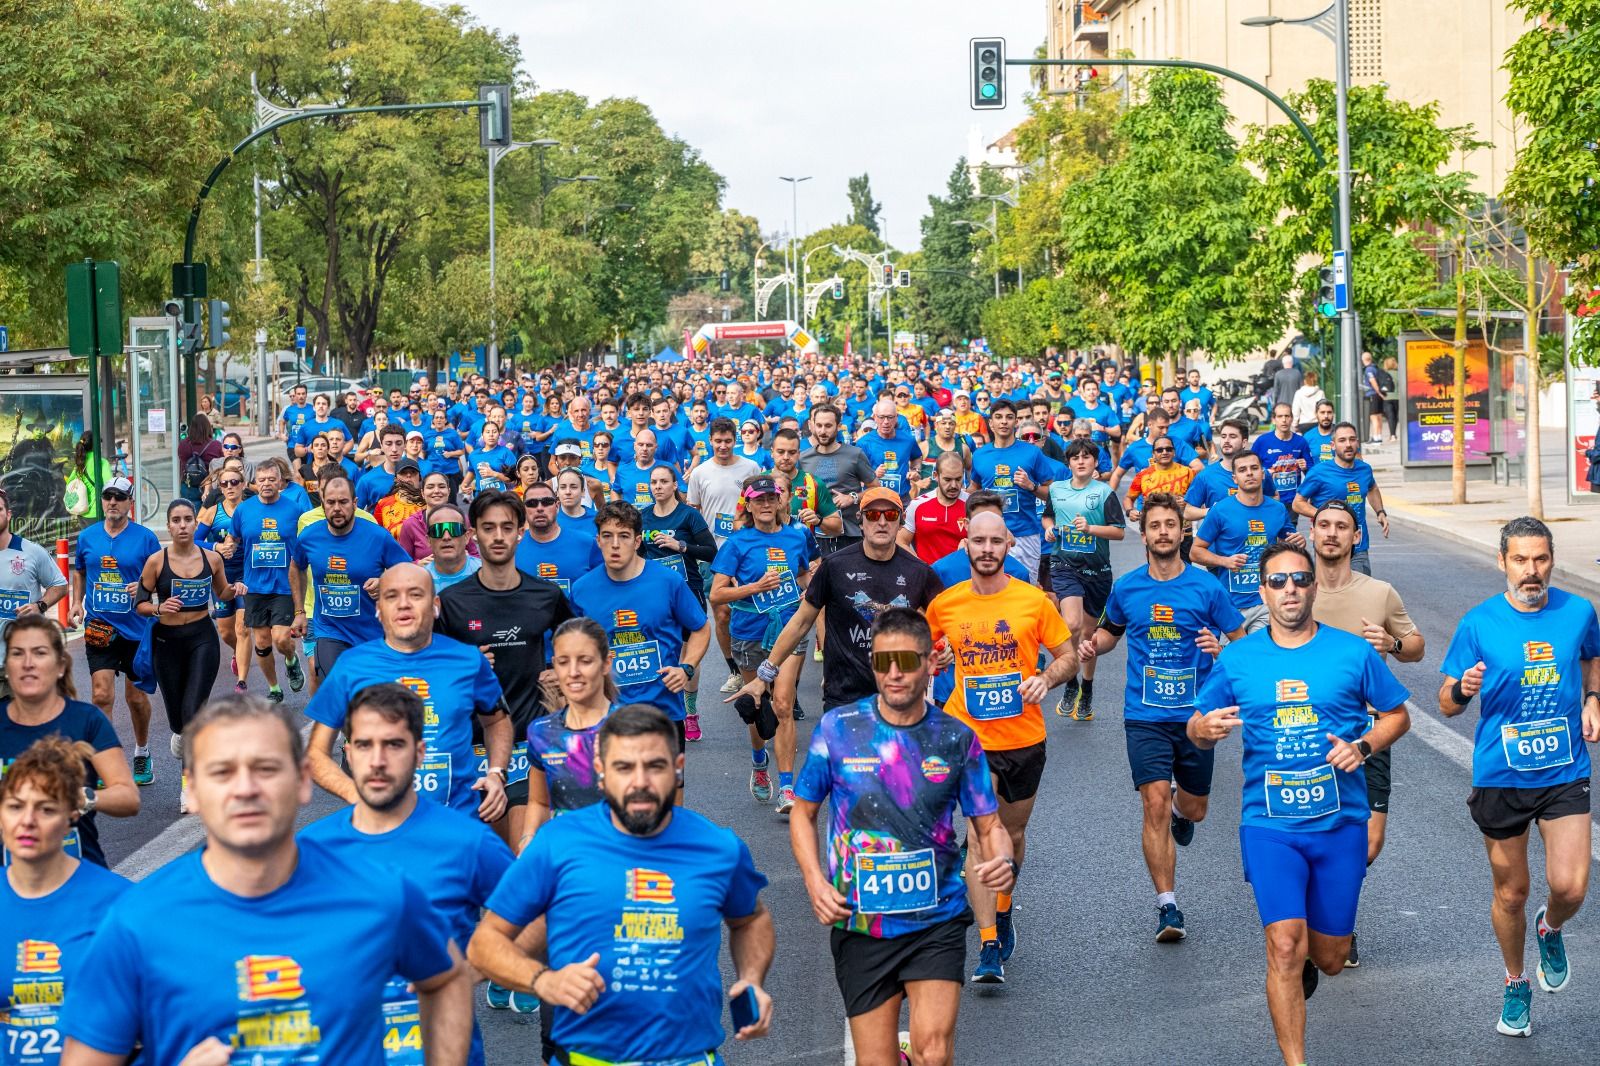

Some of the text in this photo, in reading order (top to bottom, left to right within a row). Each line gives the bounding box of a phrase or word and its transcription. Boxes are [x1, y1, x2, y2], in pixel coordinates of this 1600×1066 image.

[1416, 400, 1481, 409] YELLOWSONE
[1066, 534, 1093, 545] 1741
[258, 551, 280, 560] 357
[96, 592, 128, 604] 1158
[180, 588, 206, 599] 273
[757, 582, 793, 603] 1126
[327, 596, 352, 607] 309
[615, 655, 651, 674] 045
[1154, 680, 1186, 695] 383
[975, 688, 1013, 706] 798
[1517, 735, 1559, 756] 609
[1280, 785, 1325, 804] 999
[863, 870, 931, 895] 4100
[625, 925, 684, 940] VALENCIA
[7, 1028, 62, 1056] 722
[383, 1024, 423, 1053] 44
